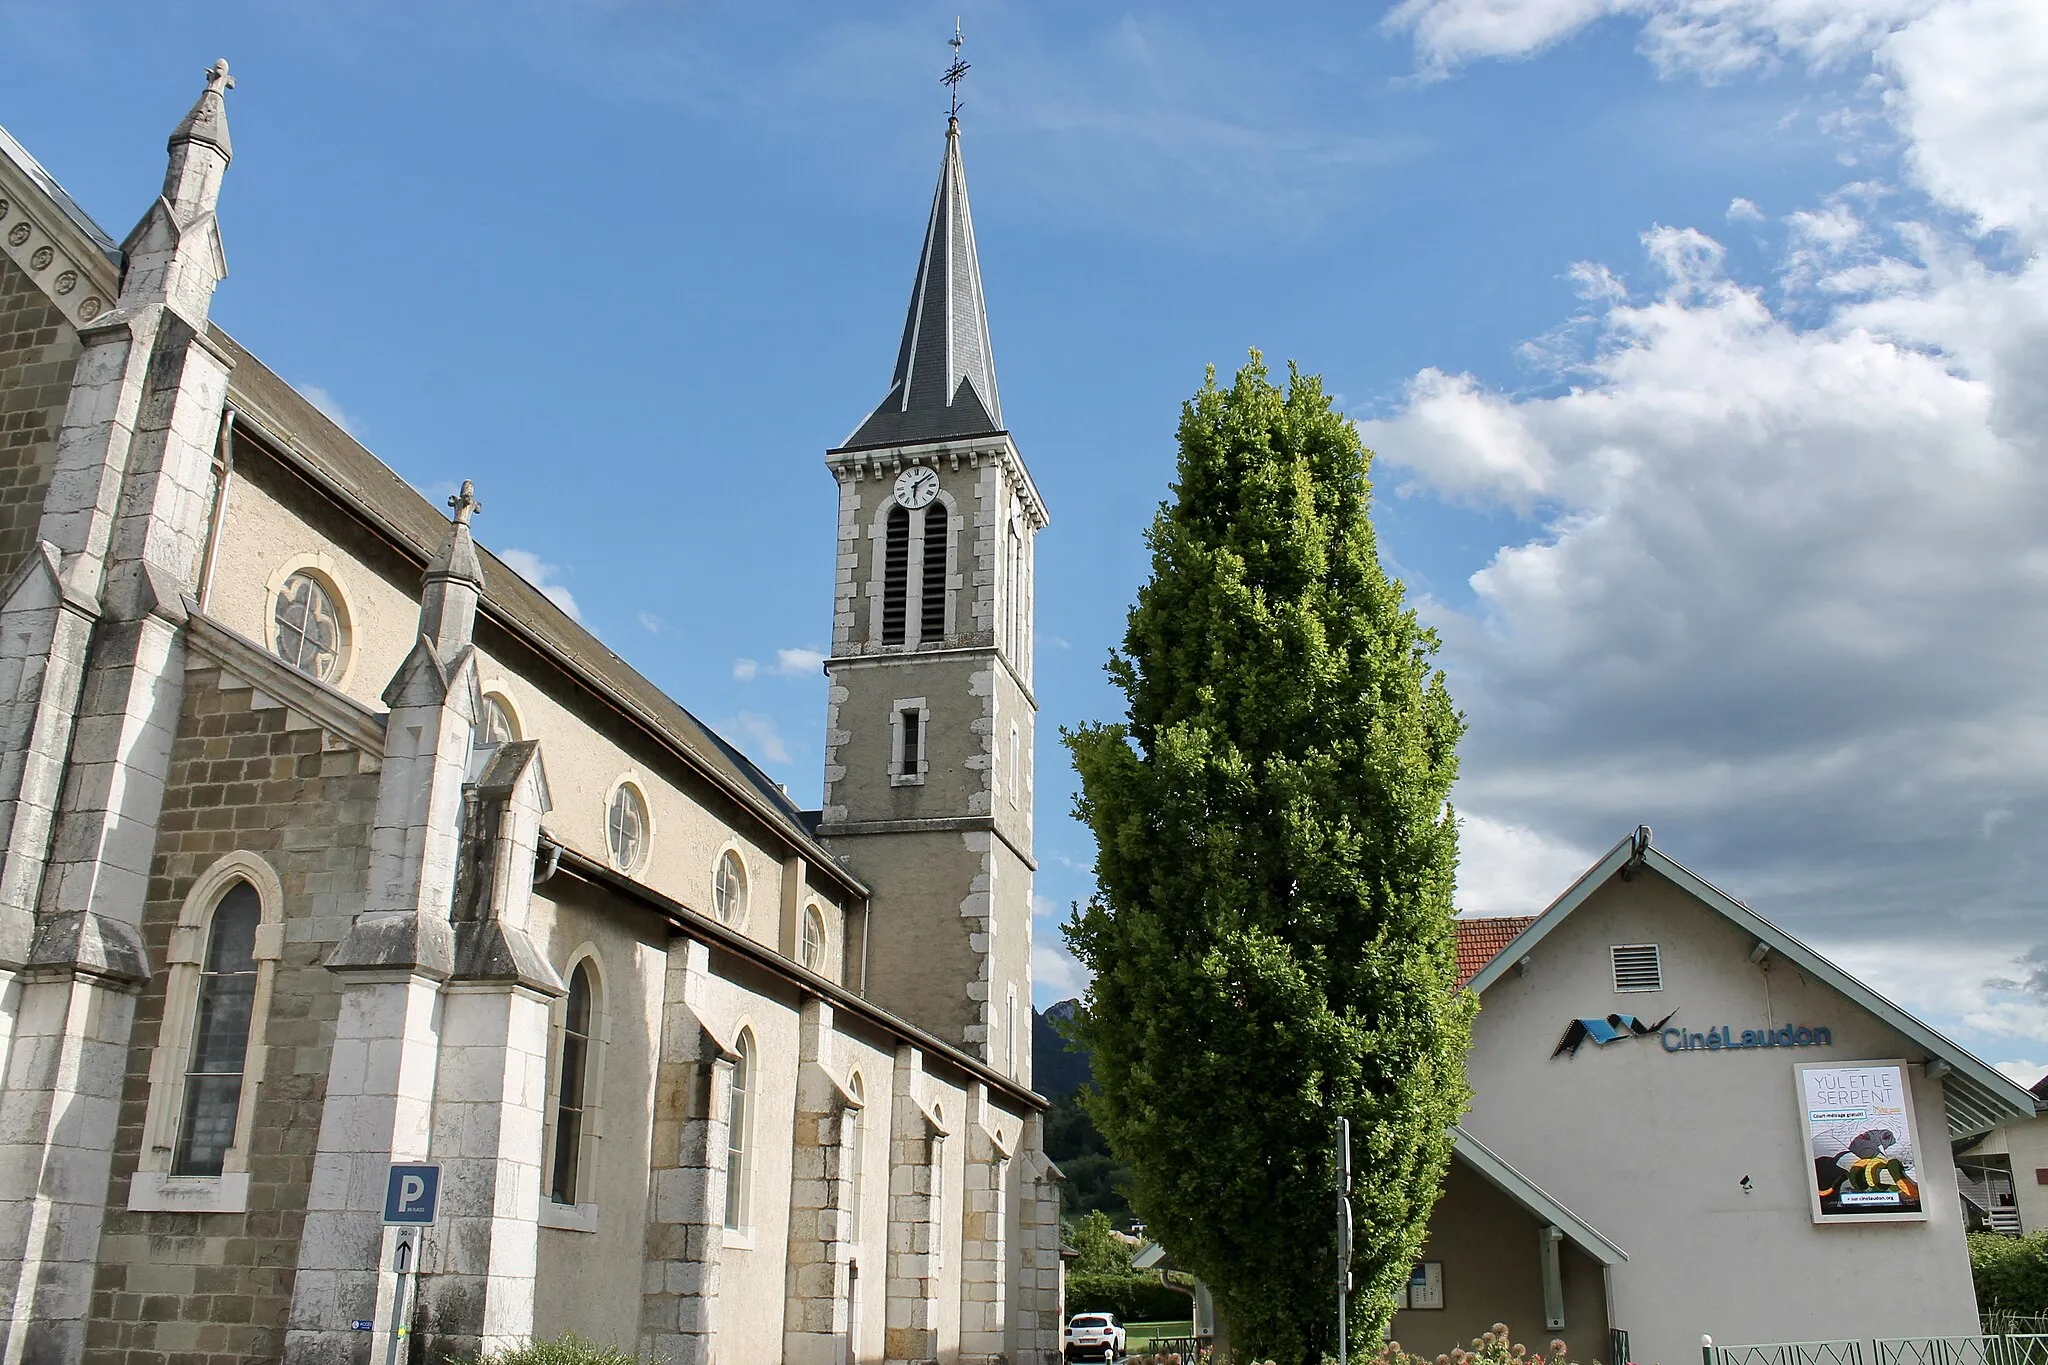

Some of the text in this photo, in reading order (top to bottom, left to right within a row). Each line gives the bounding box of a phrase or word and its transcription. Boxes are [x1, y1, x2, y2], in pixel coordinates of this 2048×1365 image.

[1660, 1023, 1832, 1052] CinéLaudon
[1813, 1073, 1891, 1090] YÙL ET LE
[1817, 1088, 1893, 1105] SERPENT
[398, 1175, 425, 1213] P
